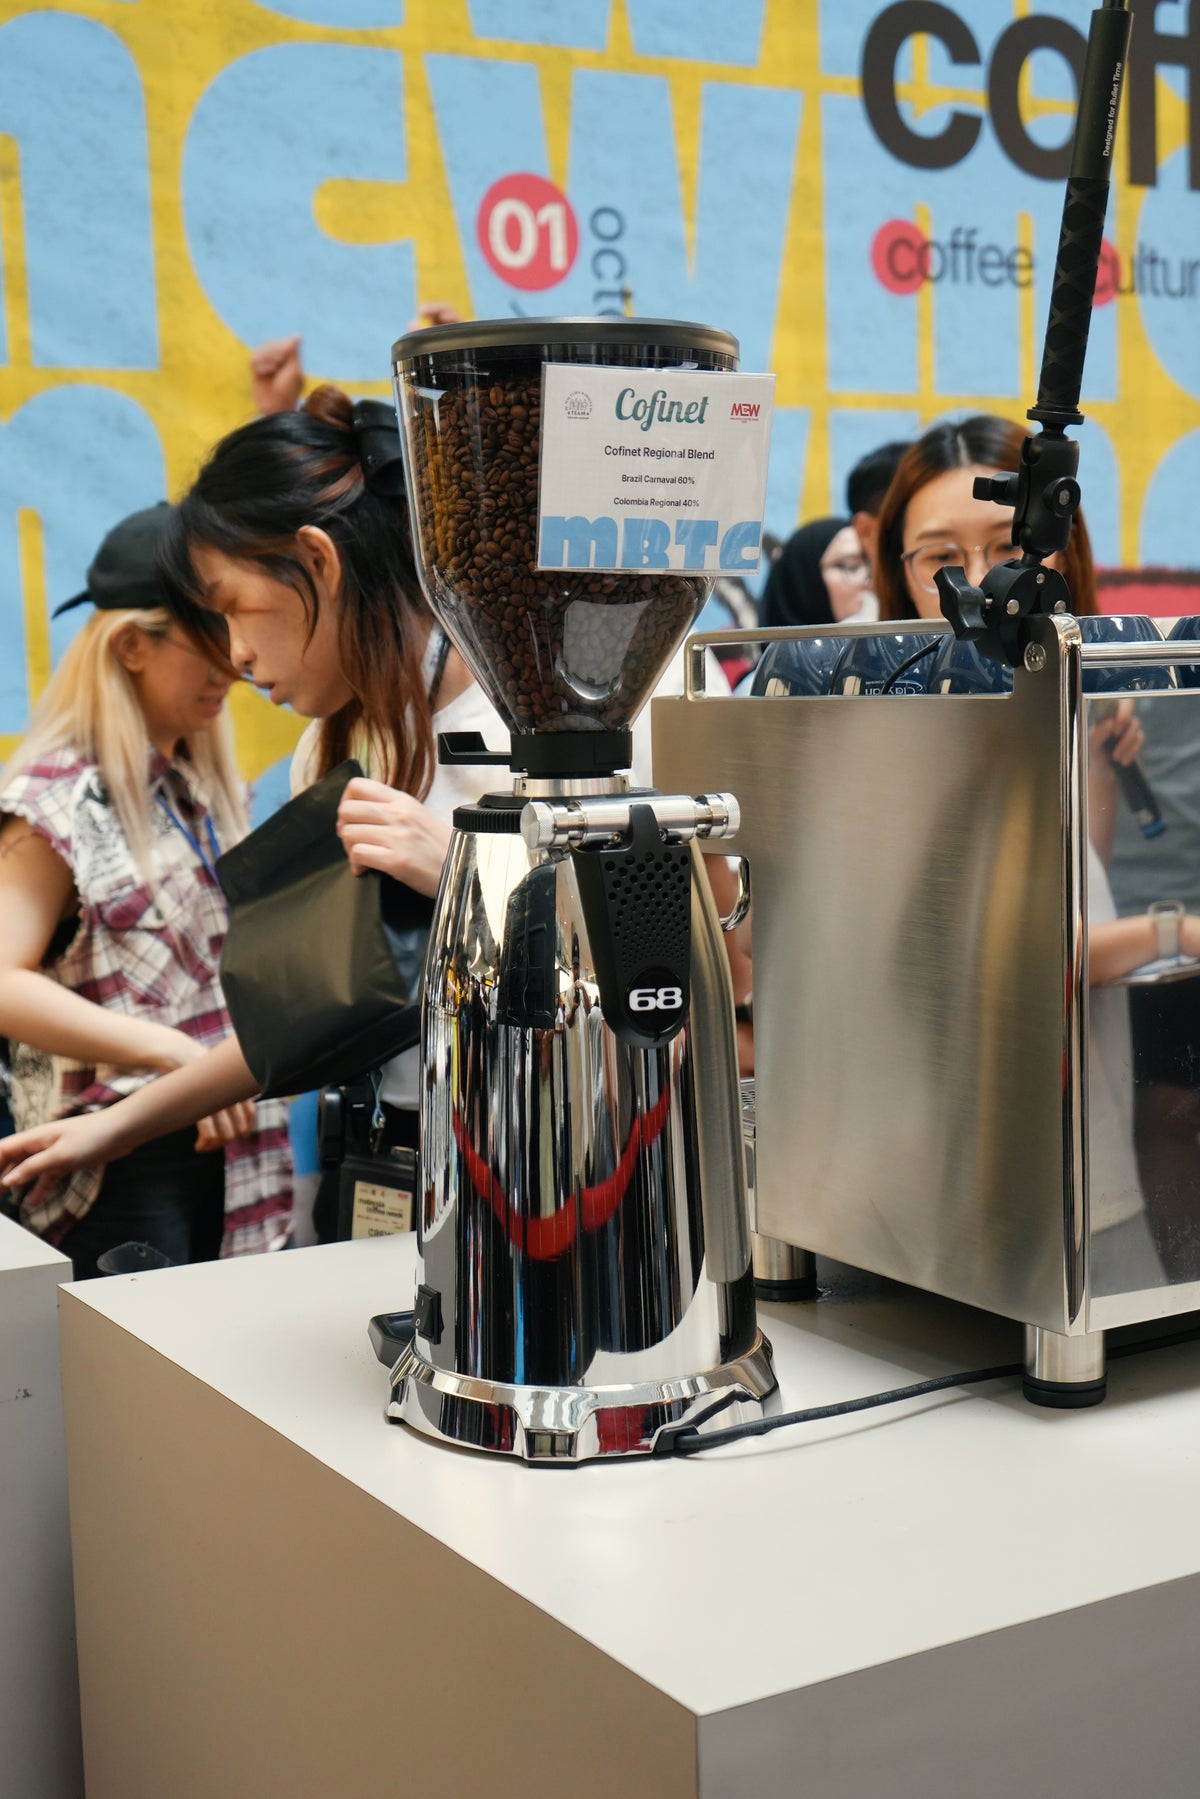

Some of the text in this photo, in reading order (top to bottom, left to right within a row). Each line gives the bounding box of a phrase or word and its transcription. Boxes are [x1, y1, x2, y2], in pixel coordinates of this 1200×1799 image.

[1102, 62, 1122, 157] Designed for Bullet Time
[488, 197, 568, 271] 01
[588, 206, 633, 317] oct
[887, 225, 1034, 288] coffee
[615, 387, 709, 432] Cofinet
[604, 445, 715, 460] Cofinet Regional Blend
[621, 474, 695, 485] Brazil Carnaval 60%
[613, 497, 700, 508] Colombia Regional 40%
[865, 686, 917, 696] Clayan
[629, 986, 683, 1012] 68
